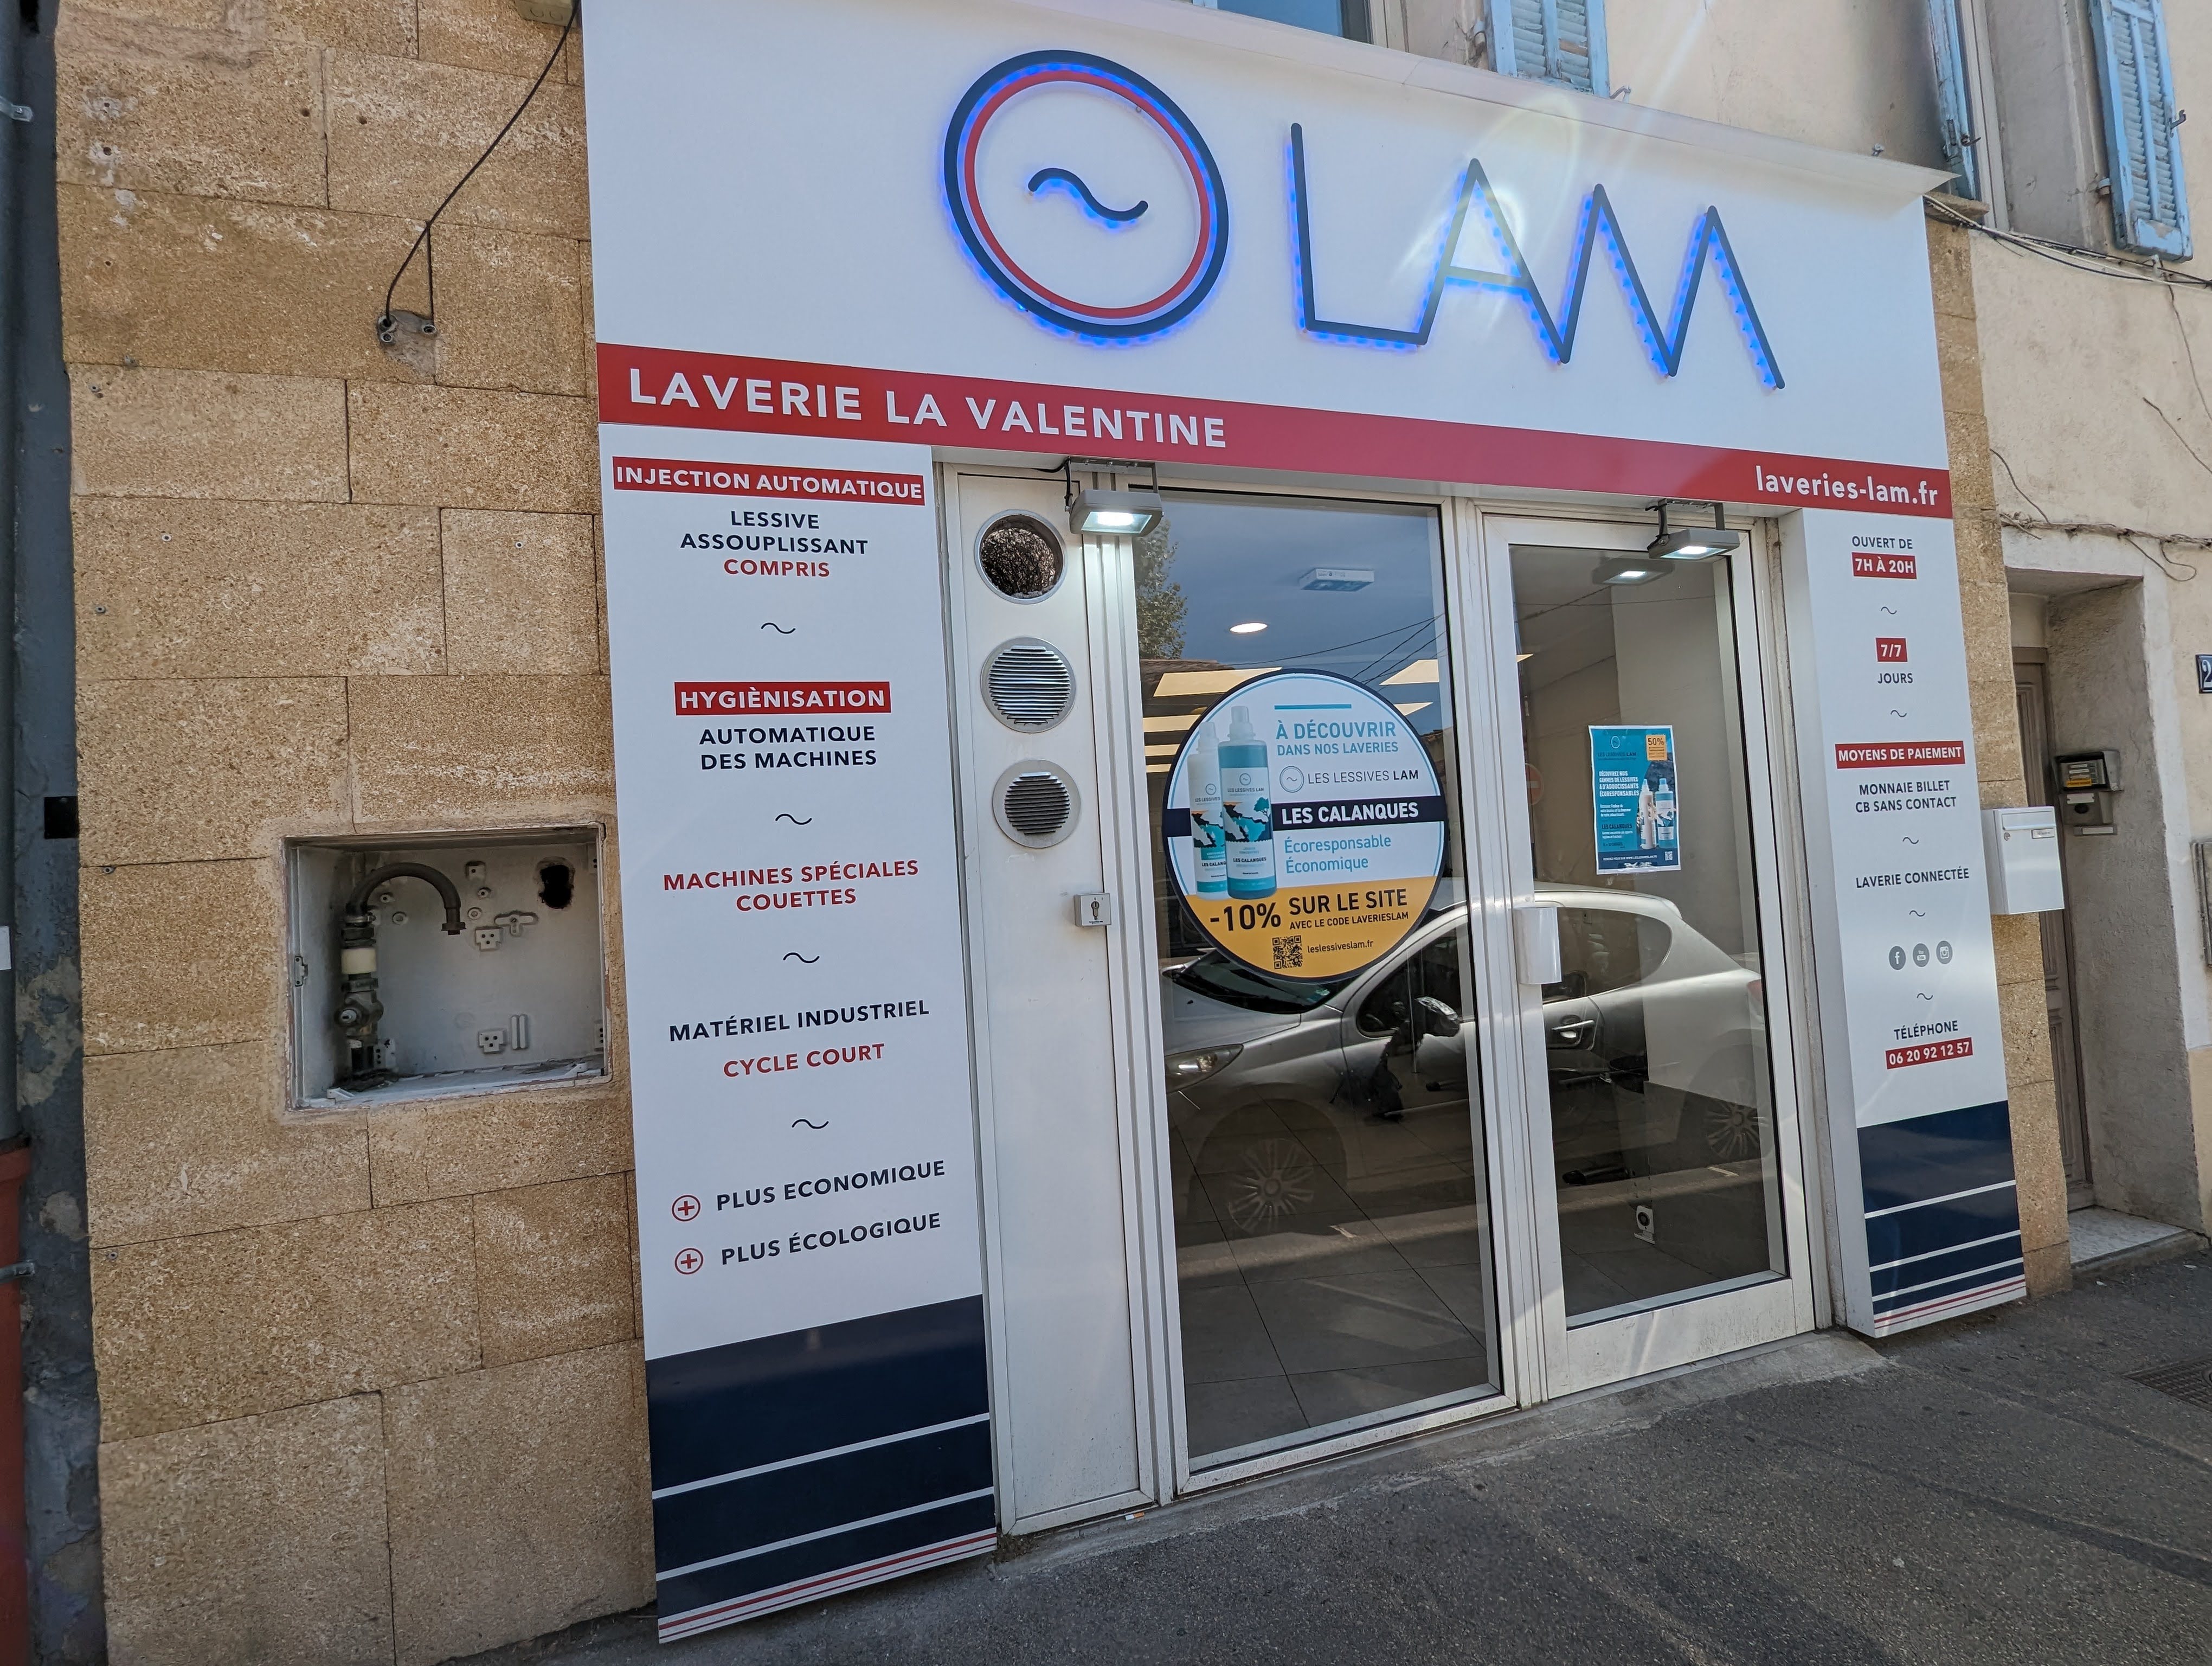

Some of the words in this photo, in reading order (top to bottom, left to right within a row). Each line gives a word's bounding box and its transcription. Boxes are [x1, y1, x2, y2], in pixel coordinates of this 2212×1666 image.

[629, 368, 862, 420] LAVERIE
[886, 390, 948, 427] LA
[966, 397, 1226, 448] VALENTINE
[617, 467, 750, 489] INJECTION
[757, 475, 922, 499] AUTOMATIQUE
[1756, 465, 1938, 505] laveries-lam.fr
[731, 511, 819, 529] LESSIVE
[680, 533, 868, 554] ASSOUPLISSANT
[1852, 536, 1894, 549] OUVERT
[1899, 539, 1912, 549] DE
[724, 559, 830, 577] COMPRIS
[1855, 559, 1872, 572] 7H
[1876, 556, 1886, 573] À
[1889, 560, 1914, 574] 20H
[1880, 644, 1901, 657] 7/7
[1877, 672, 1913, 684] JOURS
[681, 686, 885, 709] HYGIÈNISATION
[699, 726, 875, 745] AUTOMATIQUE
[1276, 721, 1288, 740] À
[1294, 720, 1396, 739] DÉCOUVRIR
[1277, 744, 1310, 756] DANS
[1315, 743, 1339, 754] NOS
[1342, 741, 1398, 753] LAVERIES
[1838, 747, 1887, 762] MOYENS
[1891, 747, 1905, 759] DE
[1908, 746, 1962, 759] PAIEMENT
[700, 753, 746, 770] DES
[755, 749, 877, 769] MACHINES
[1308, 772, 1329, 784] LES
[1333, 770, 1389, 784] LESSIVES
[1393, 769, 1419, 780] LAM
[1859, 783, 1913, 796] MONNAIE
[1917, 780, 1950, 793] BILLET
[1282, 808, 1313, 825] LES
[1317, 802, 1418, 823] CALANQUES
[1856, 802, 1870, 813] CB
[1873, 799, 1902, 812] SANS
[1906, 796, 1957, 810] CONTACT
[1284, 834, 1391, 854] Écoresponsable
[1286, 856, 1368, 874] Économique
[664, 867, 794, 891] MACHINES
[801, 860, 919, 883] SPÉCIALES
[1856, 874, 1901, 888] LAVERIE
[1905, 866, 1969, 885] CONNECTÉE
[736, 888, 857, 912] COUETTES
[1289, 896, 1330, 916] SUR
[1337, 892, 1358, 911] LE
[1365, 889, 1407, 908] SITE
[1210, 901, 1281, 932] -10%
[1289, 920, 1311, 930] AVEC
[1314, 918, 1324, 928] LE
[1327, 915, 1349, 927] CODE
[1351, 911, 1409, 925] LAVERIESLAM
[1307, 939, 1373, 954] leslessiveslam.fr
[669, 1015, 790, 1042] MATÉRIEL
[798, 999, 930, 1028] INDUSTRIEL
[1894, 1020, 1959, 1040] TÉLÉPHONE
[723, 1053, 799, 1078] CYCLE
[807, 1043, 885, 1068] COURT
[1889, 1053, 1904, 1066] 06
[1907, 1050, 1920, 1063] 20
[1923, 1048, 1937, 1061] 92
[1940, 1045, 1953, 1058] 12
[1957, 1042, 1970, 1055] 57
[717, 1186, 775, 1211] PLUS
[783, 1160, 946, 1200] ECONOMIQUE
[722, 1240, 781, 1265] PLUS
[789, 1213, 941, 1253] ÉCOLOGIQUE
